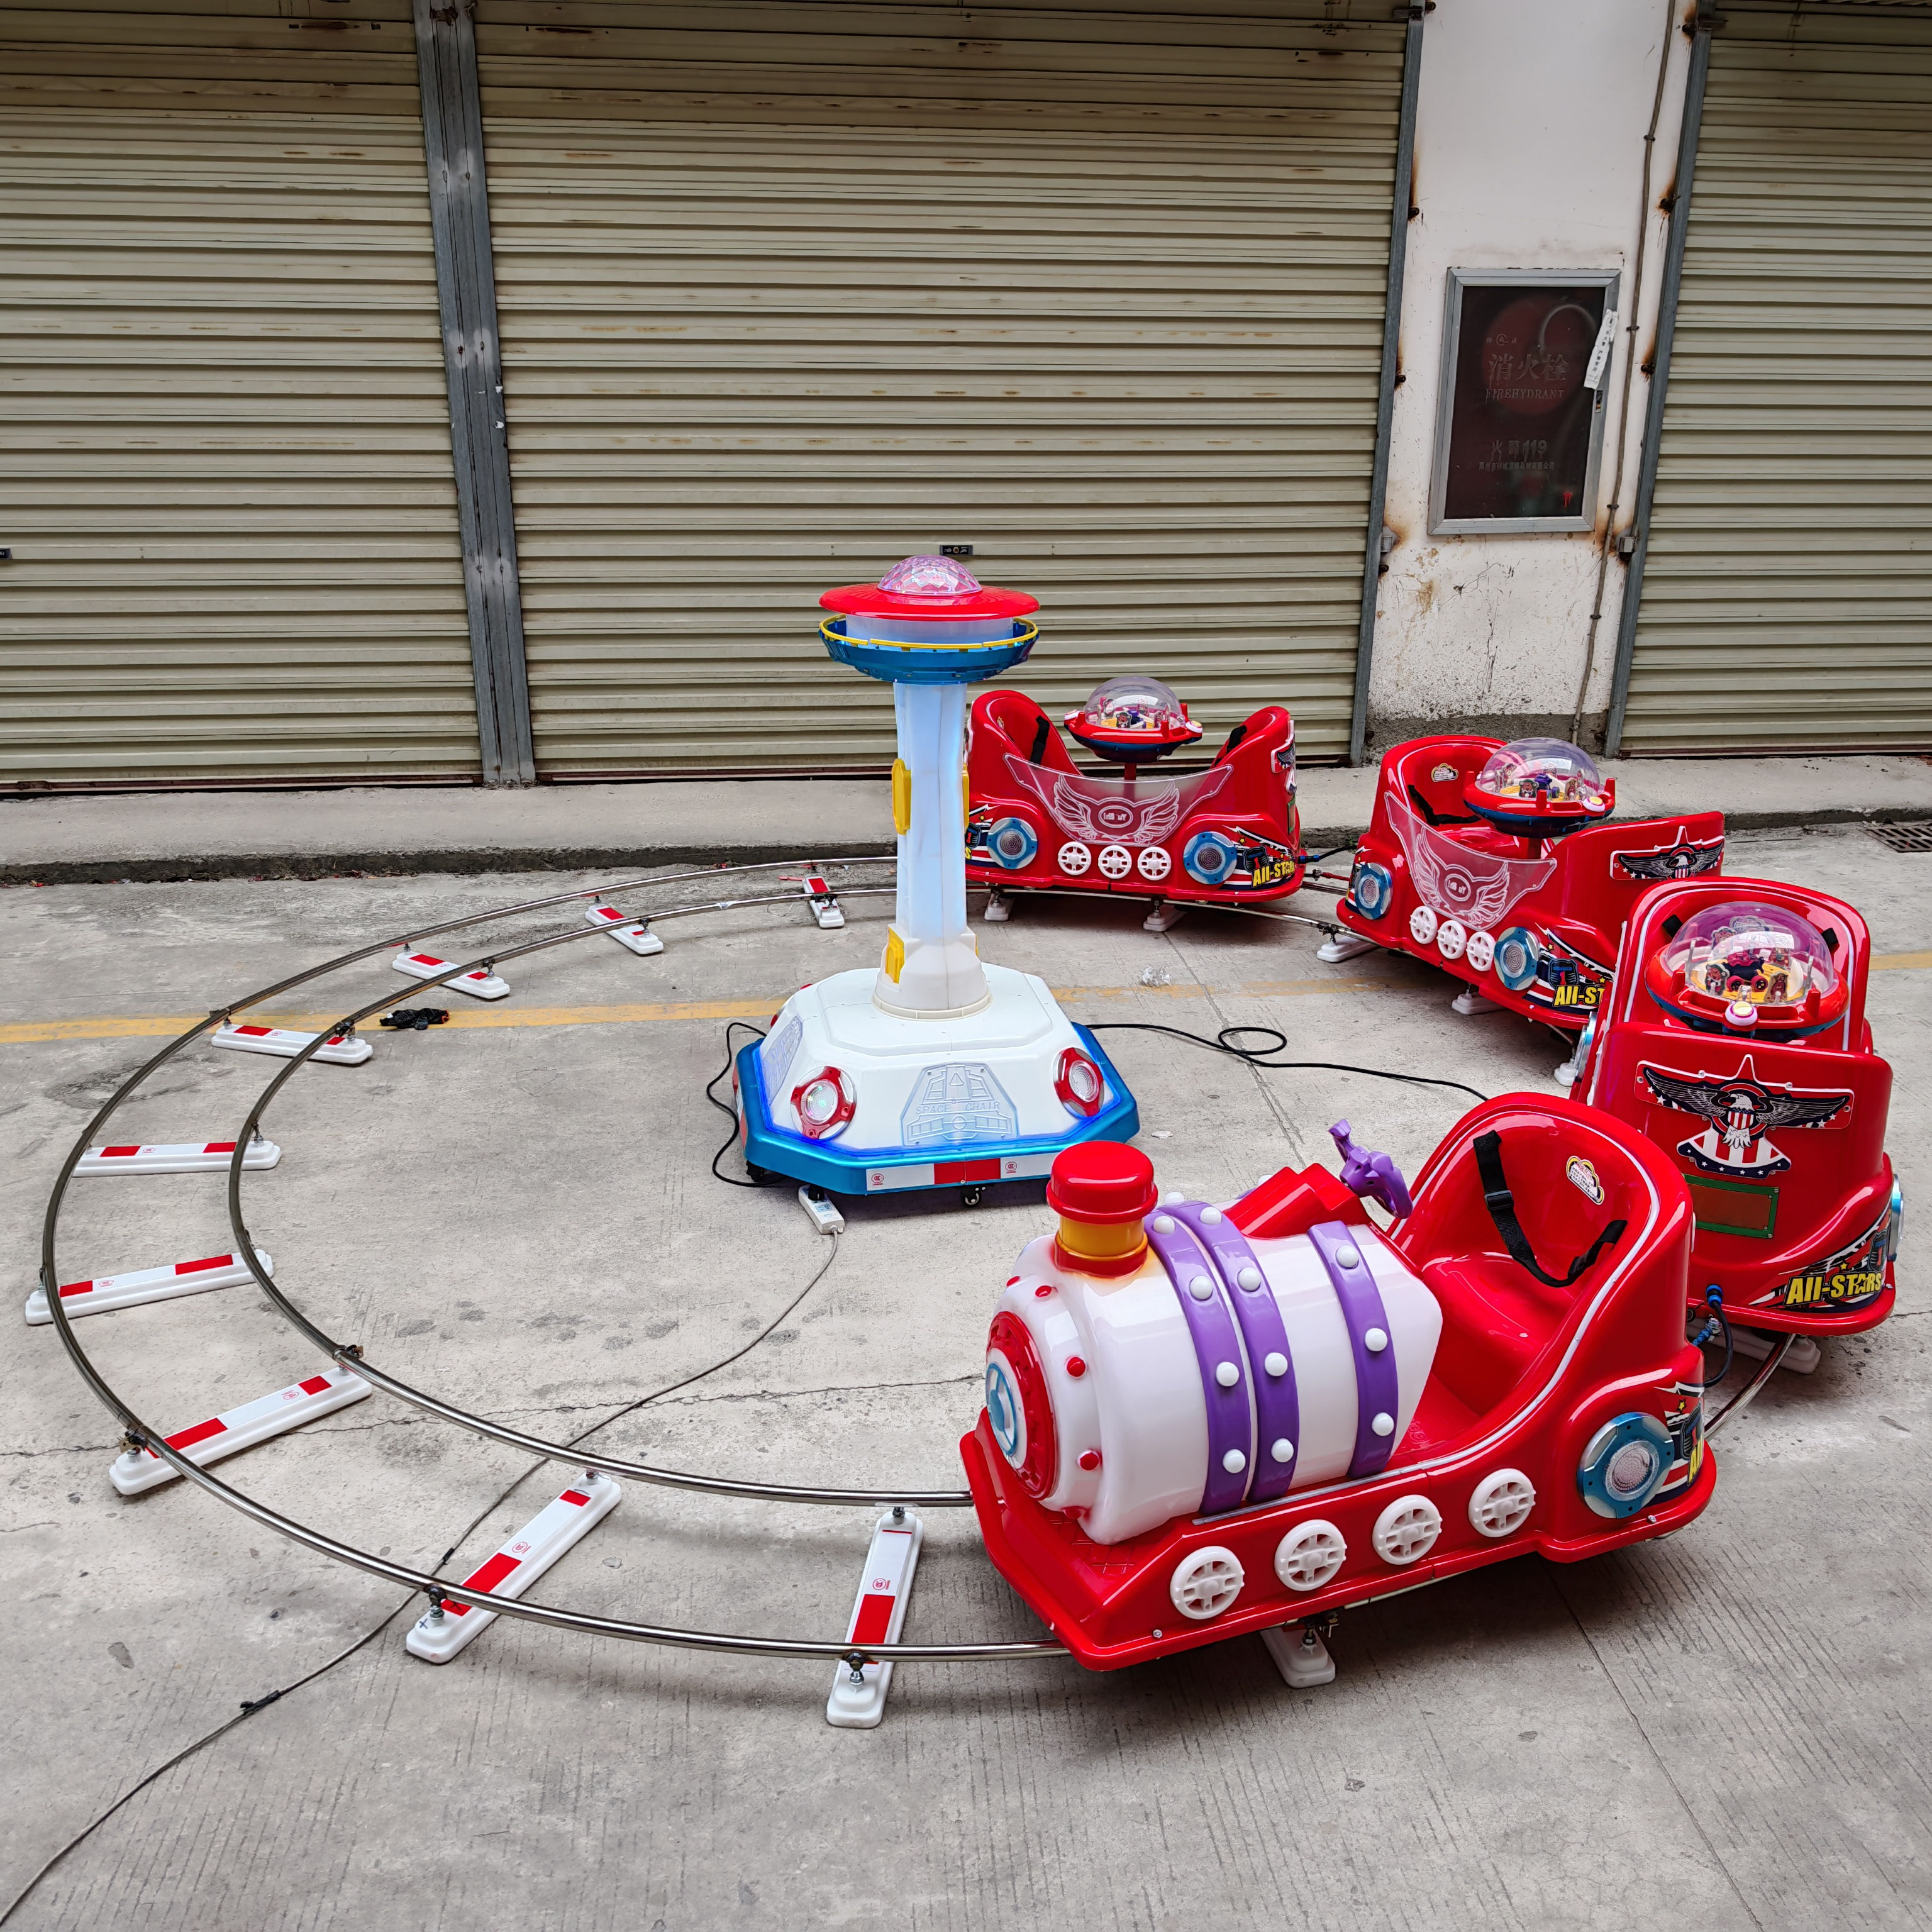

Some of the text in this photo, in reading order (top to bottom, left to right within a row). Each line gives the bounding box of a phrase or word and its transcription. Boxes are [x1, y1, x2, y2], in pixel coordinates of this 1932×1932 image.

[1489, 352, 1570, 381] 消火栓
[915, 1101, 1001, 1114] SPACE CHAIR
[1786, 1272, 1882, 1305] All-STARS
